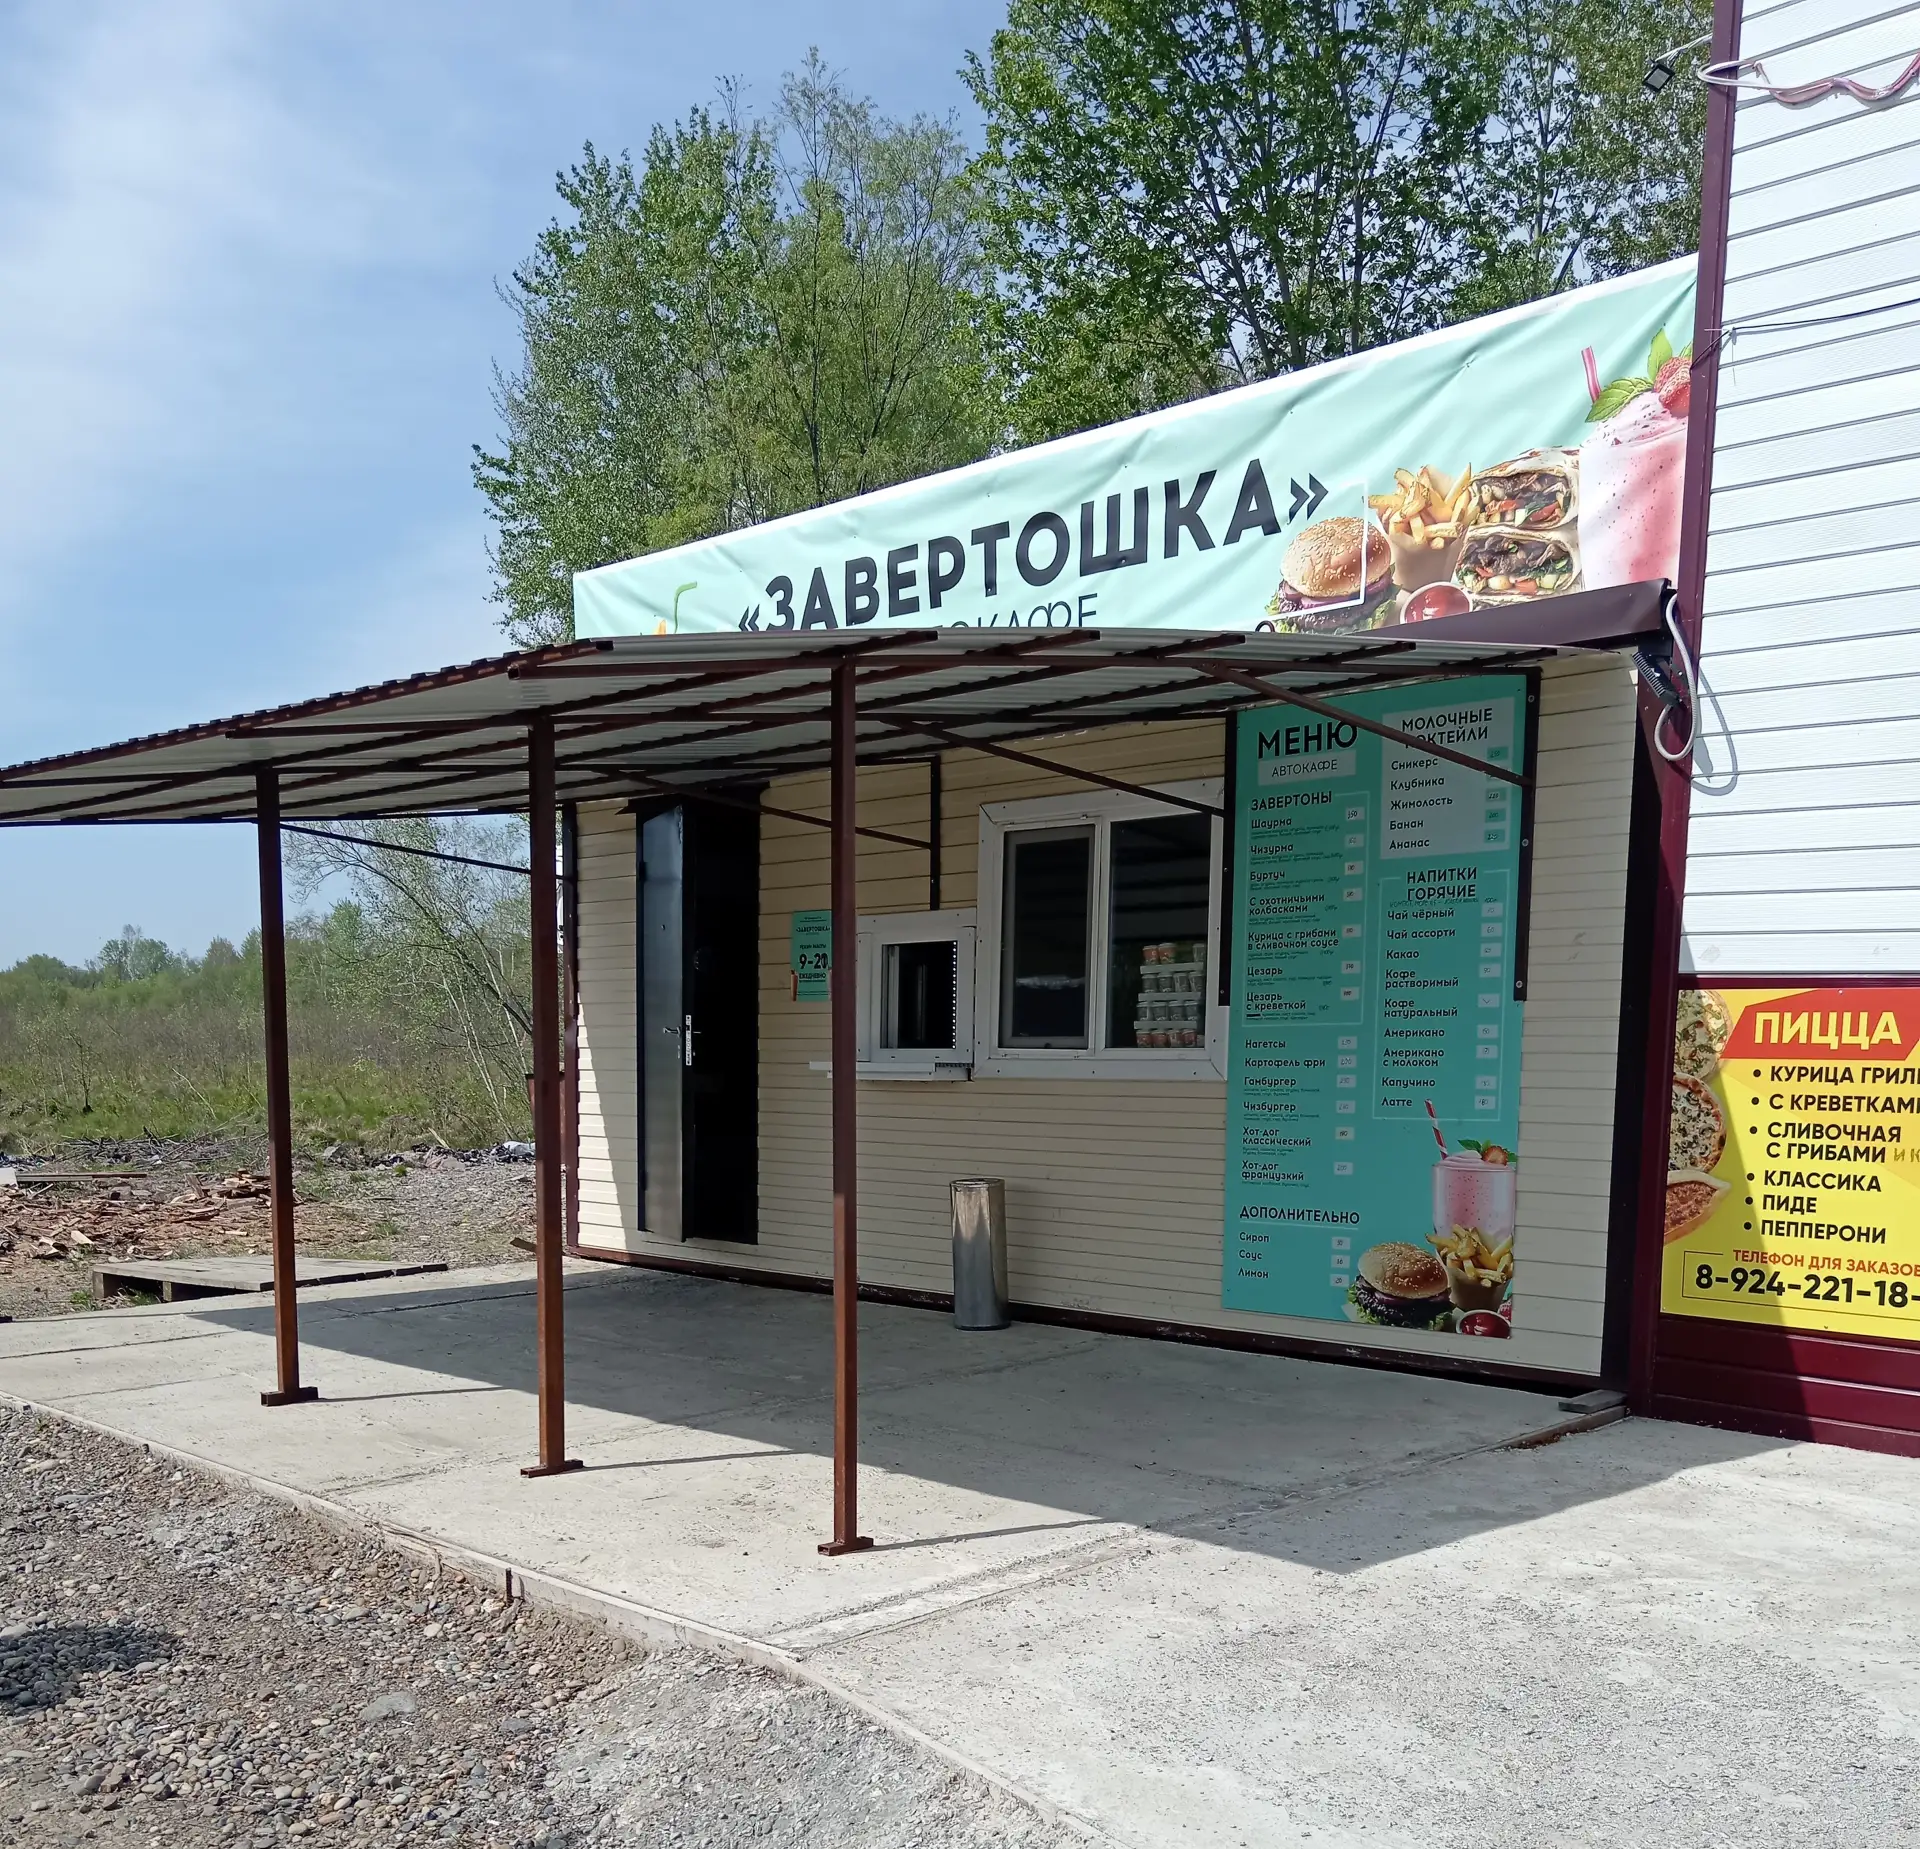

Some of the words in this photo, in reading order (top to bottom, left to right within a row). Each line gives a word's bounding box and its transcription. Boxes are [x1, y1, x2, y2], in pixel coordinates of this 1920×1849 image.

[738, 458, 1329, 633] «ЗАВЕРТОШКА»
[1402, 708, 1493, 732] МОЛОЧНЫЕ
[1258, 721, 1358, 759] МЕНЮ
[1271, 758, 1338, 778] АВТОКАФЕ
[1391, 757, 1438, 771] Сникерс
[1390, 776, 1445, 791] Клубника
[1251, 790, 1332, 811] ЗАВЕРТОНЫ
[1390, 797, 1453, 811] Жимолость
[1251, 816, 1292, 830] Шаурма
[1389, 819, 1424, 831] Банан
[1250, 843, 1294, 856] Чизурма
[1389, 839, 1430, 850] Ананас
[1250, 870, 1285, 882] Буртуч
[1407, 867, 1477, 884] НАПИТКИ
[1407, 884, 1476, 901] ГОРЯЧИЕ
[1250, 897, 1256, 906] С
[1260, 894, 1325, 906] охотничьими
[1249, 904, 1308, 916] колбасками
[1388, 910, 1408, 920] Чай
[1412, 908, 1455, 921] чёрный
[1248, 931, 1284, 944] Курица
[1286, 932, 1293, 940] с
[1295, 928, 1336, 940] грибами
[1387, 929, 1408, 940] Чай
[1411, 928, 1456, 939] ассорти
[1248, 943, 1253, 951] в
[1256, 940, 1308, 951] сливочном
[1310, 938, 1339, 951] соусе
[1386, 949, 1420, 960] Какао
[1247, 966, 1283, 978] Цезарь
[1385, 969, 1416, 980] Кофе
[1385, 976, 1459, 990] растворимый
[1246, 992, 1282, 1003] Цезарь
[1254, 1000, 1306, 1012] креветкой
[1384, 998, 1415, 1010] Кофе
[1384, 1006, 1458, 1020] натуральный
[1384, 1028, 1445, 1039] Американо
[1753, 1011, 1902, 1050] ПИЦЦА
[1245, 1039, 1286, 1049] Нагетсы
[1383, 1048, 1445, 1059] Американо
[1244, 1058, 1300, 1069] Картофель
[1303, 1058, 1326, 1068] фри
[1392, 1059, 1439, 1068] молоком
[1244, 1076, 1297, 1088] Гамбургер
[1770, 1065, 1855, 1087] КУРИЦА
[1861, 1066, 1920, 1085] ГРИЛ
[1381, 1077, 1436, 1089] Капучино
[1244, 1101, 1296, 1113] Чизбургер
[1381, 1097, 1413, 1108] Латте
[1768, 1094, 1784, 1110] С
[1790, 1094, 1920, 1114] КРЕВЕТКАМ
[1242, 1126, 1280, 1137] Хот-дог
[1767, 1122, 1902, 1144] СЛИВОЧНАЯ
[1242, 1136, 1312, 1147] классический
[1766, 1142, 1781, 1158] С
[1786, 1143, 1886, 1164] ГРИБАМИ
[1242, 1160, 1279, 1171] Хот-дог
[1242, 1170, 1304, 1182] французкий
[1763, 1170, 1882, 1192] КЛАССИКА
[1762, 1194, 1818, 1216] ПИДЕ
[1240, 1205, 1360, 1224] ДОПОЛНИТЕЛЬНО
[1239, 1232, 1270, 1244] Сироп
[1760, 1220, 1887, 1244] ПЕППЕРОНИ
[1238, 1250, 1263, 1262] Соус
[1732, 1248, 1805, 1268] ТЕЛЕФОН
[1807, 1255, 1842, 1272] ДЛЯ
[1238, 1267, 1269, 1279] Лимон
